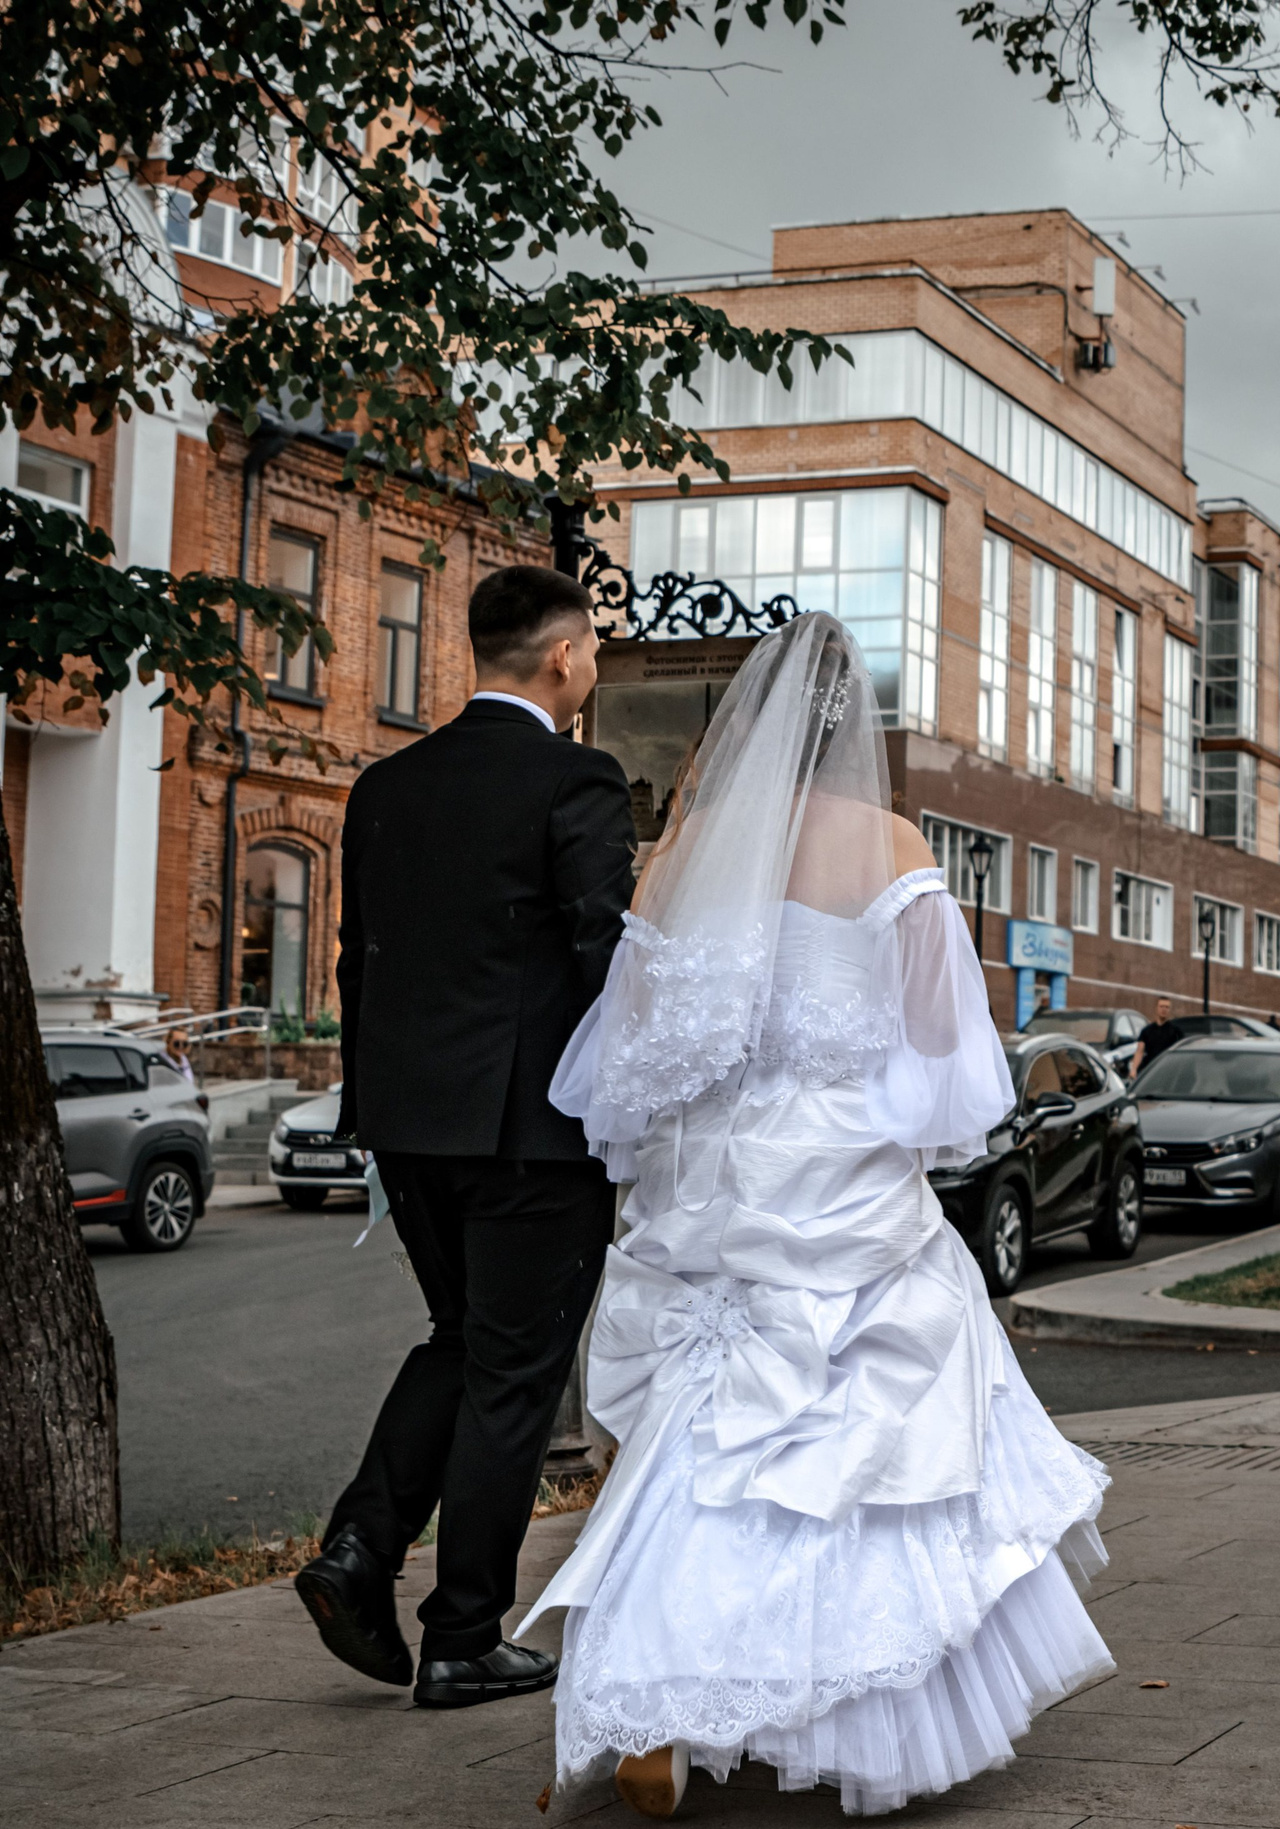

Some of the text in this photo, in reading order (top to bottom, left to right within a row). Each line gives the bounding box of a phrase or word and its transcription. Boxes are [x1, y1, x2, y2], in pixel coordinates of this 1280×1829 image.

[645, 655, 707, 665] Фотоснимок
[717, 653, 744, 662] этого
[643, 665, 698, 678] сделанный
